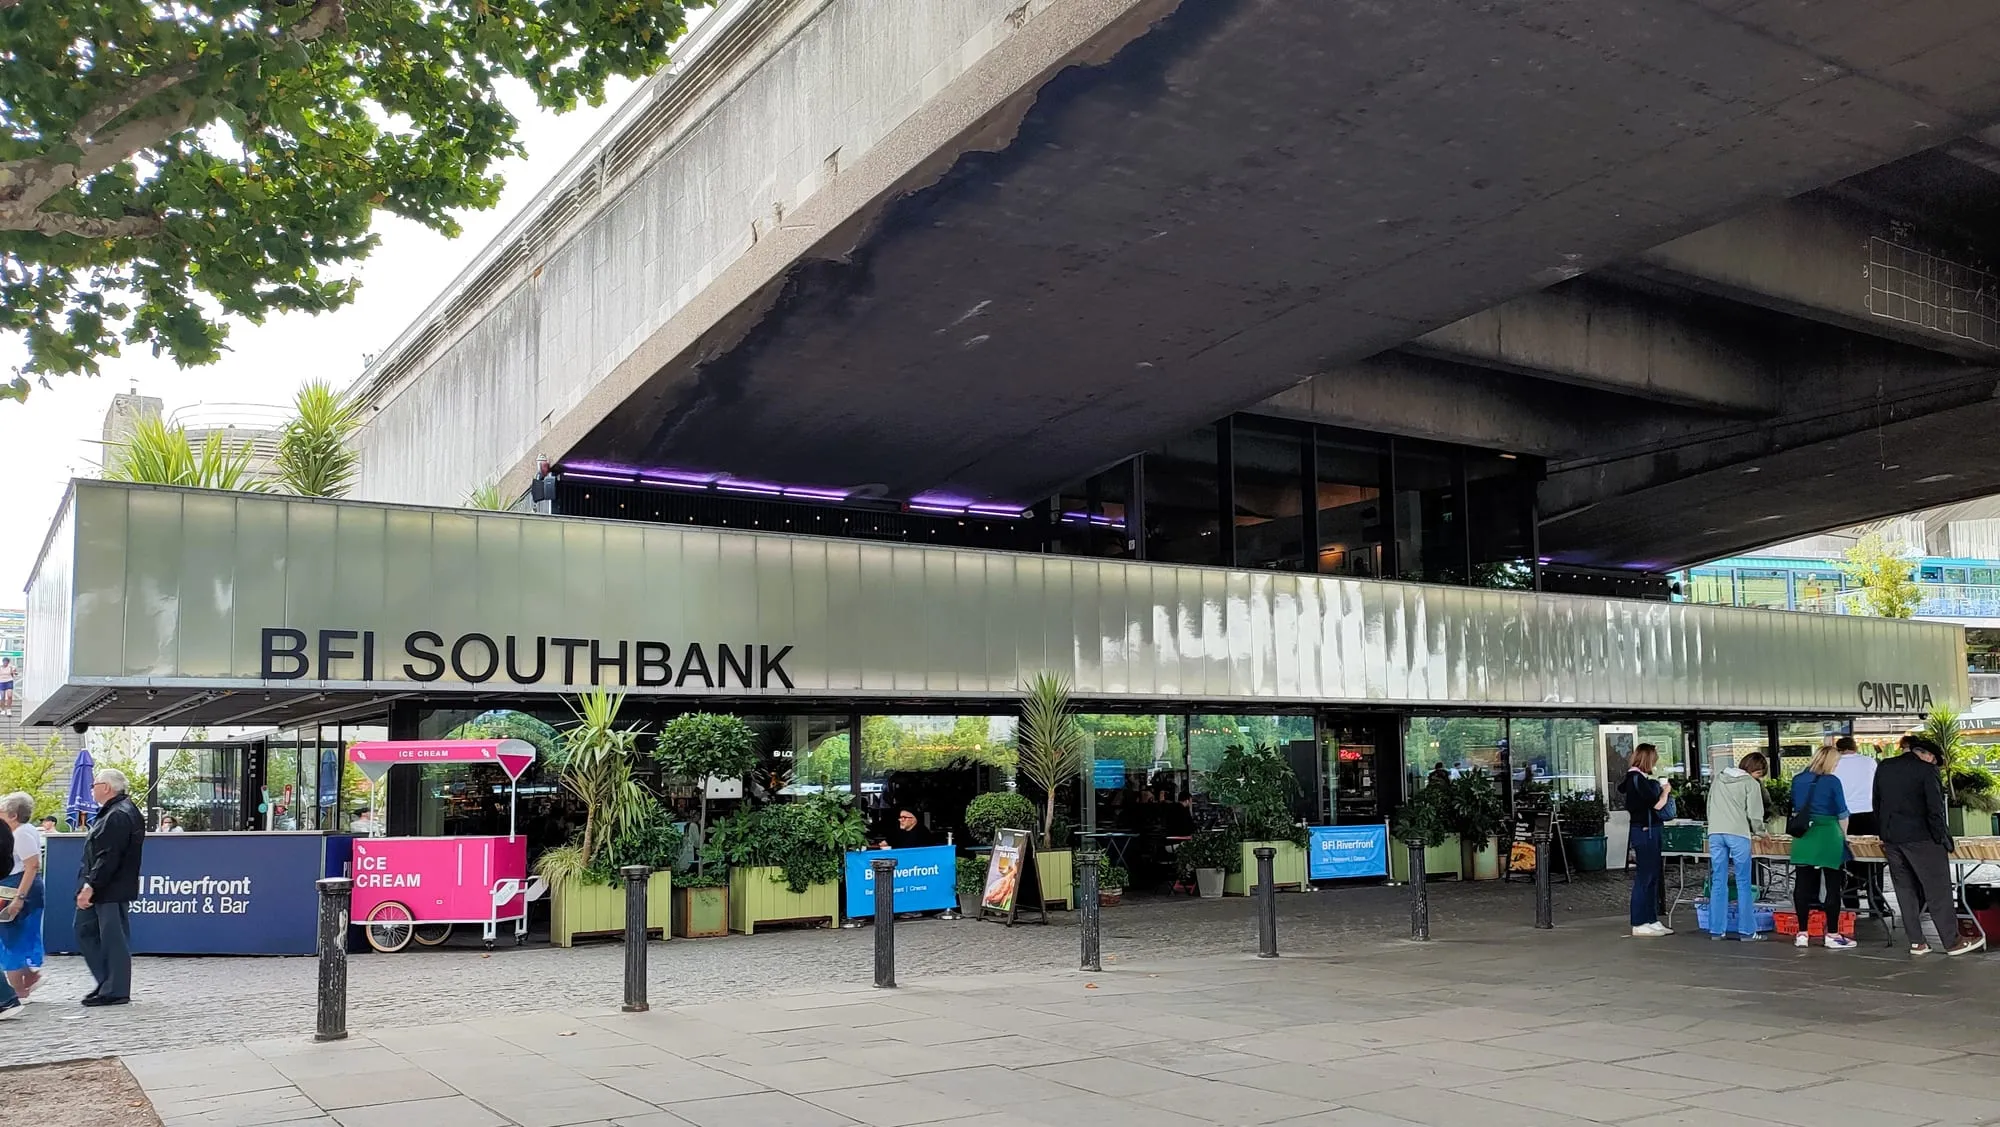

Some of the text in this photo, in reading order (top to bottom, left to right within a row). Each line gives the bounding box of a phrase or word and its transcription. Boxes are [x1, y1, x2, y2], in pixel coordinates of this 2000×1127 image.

[261, 627, 795, 689] BFI SOUTHBANK
[1858, 681, 1934, 711] CINEMA
[399, 750, 414, 758] ICE
[1336, 839, 1374, 850] Riverfront
[356, 856, 387, 871] ICE
[893, 864, 939, 879] iverfront
[149, 875, 251, 895] Riverfront
[356, 873, 421, 888] CREAM
[128, 896, 250, 914] estaurant & Bar
